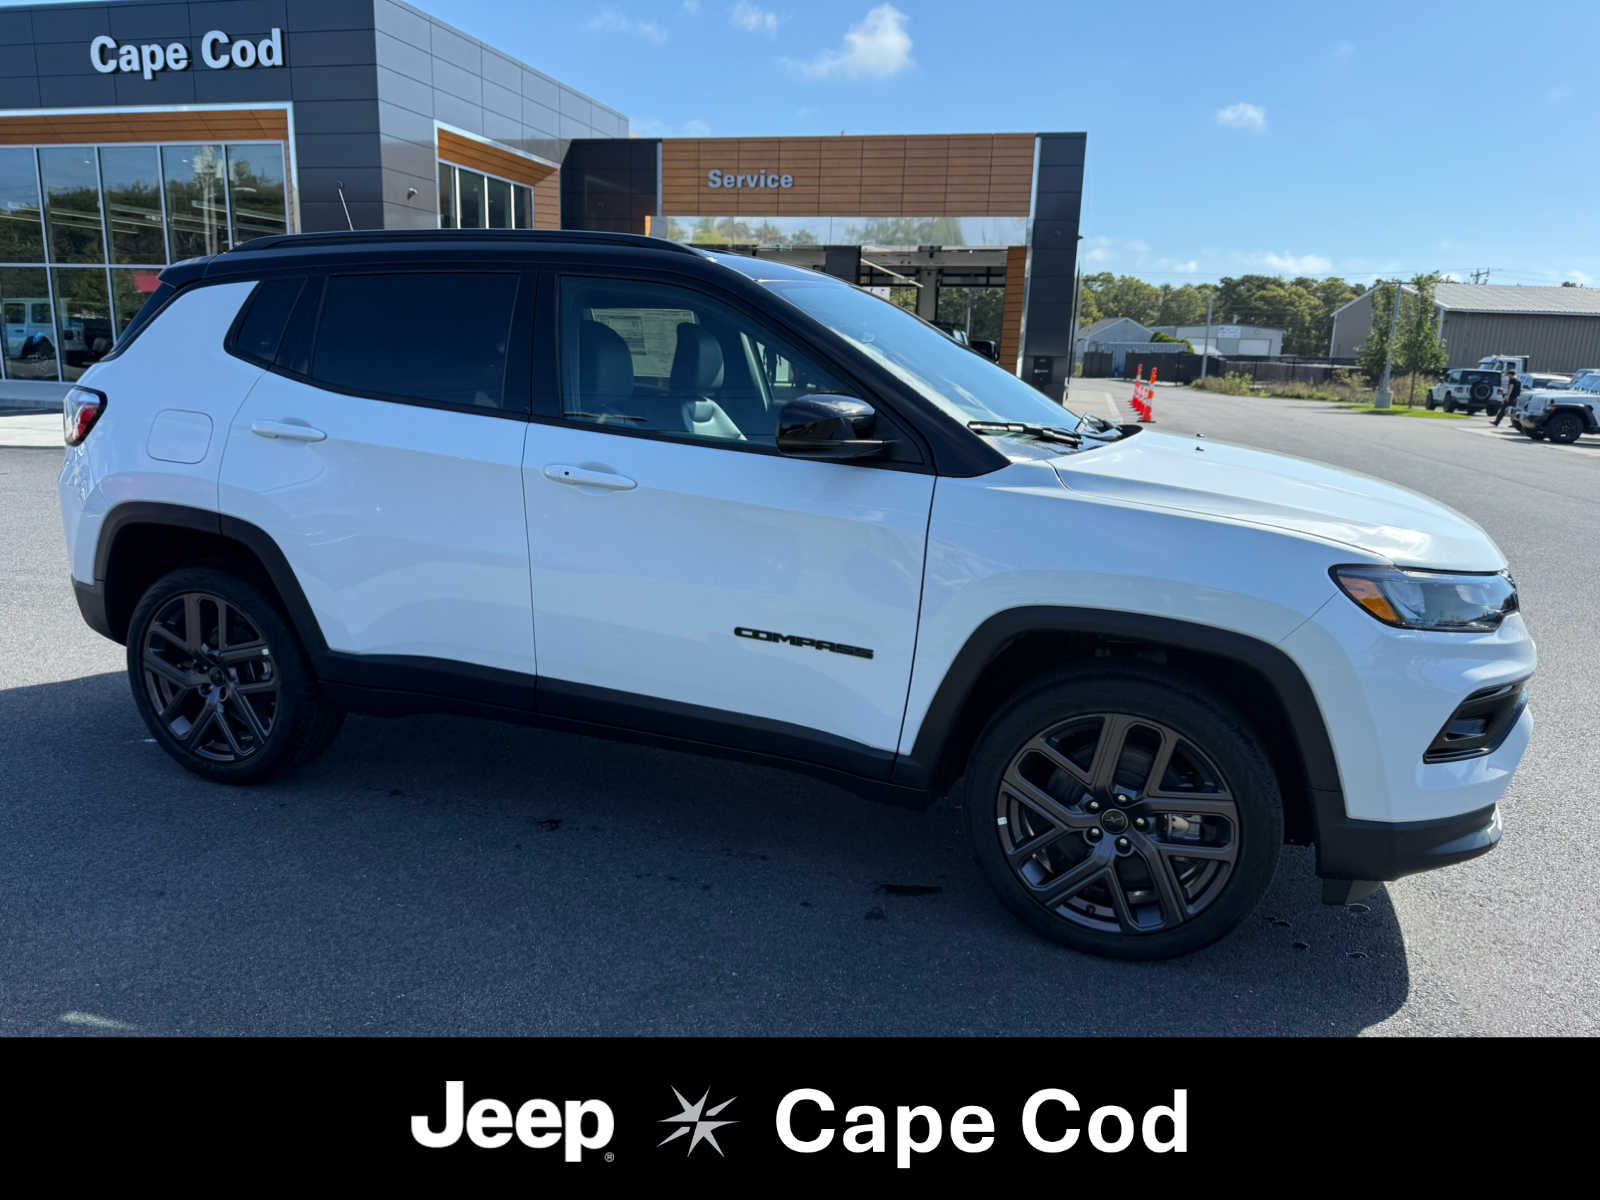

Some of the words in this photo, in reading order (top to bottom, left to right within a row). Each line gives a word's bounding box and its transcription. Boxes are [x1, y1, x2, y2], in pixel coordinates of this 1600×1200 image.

[90, 35, 189, 80] Cape
[201, 27, 284, 69] Cod
[708, 168, 794, 189] Service
[734, 626, 875, 660] COMPASS
